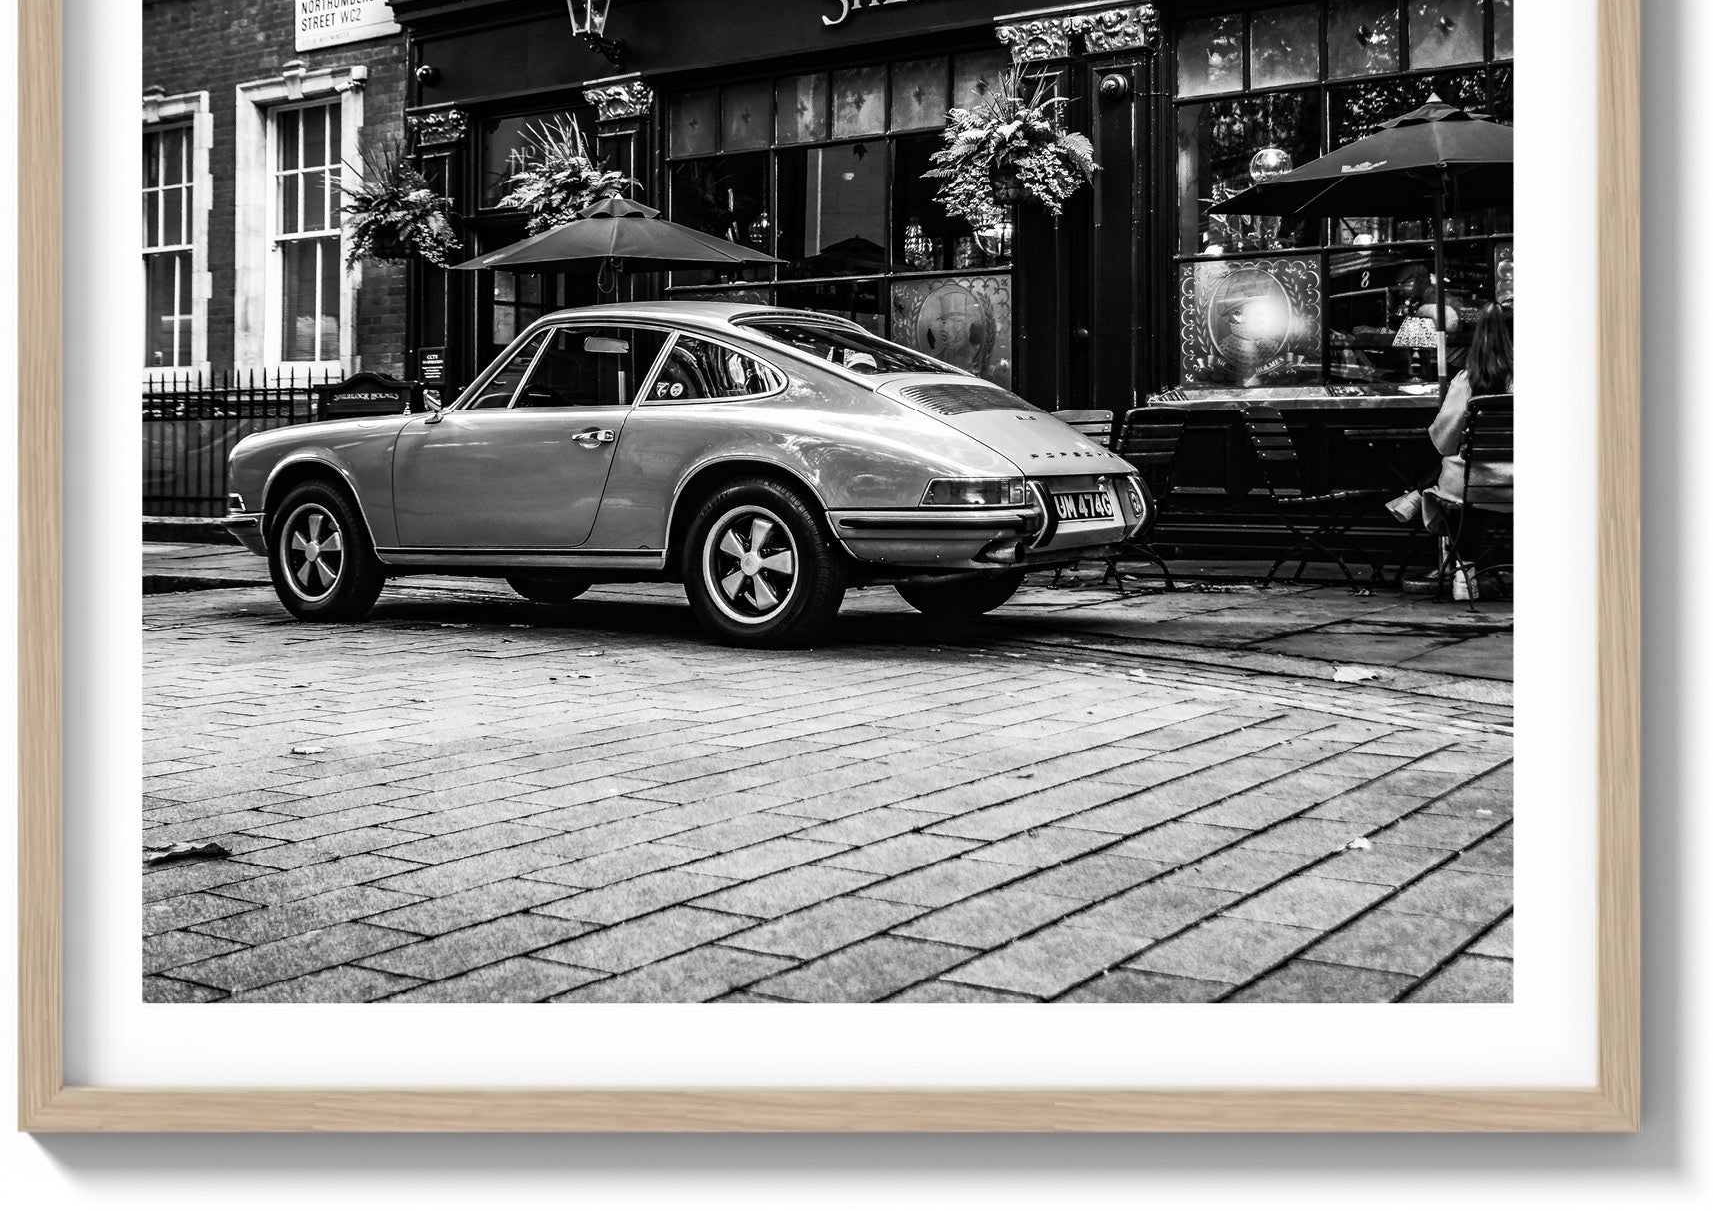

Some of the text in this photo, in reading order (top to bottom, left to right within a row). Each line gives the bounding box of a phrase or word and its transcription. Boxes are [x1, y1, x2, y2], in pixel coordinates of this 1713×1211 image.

[301, 8, 361, 32] STREET WC2
[1078, 493, 1112, 518] 474G
